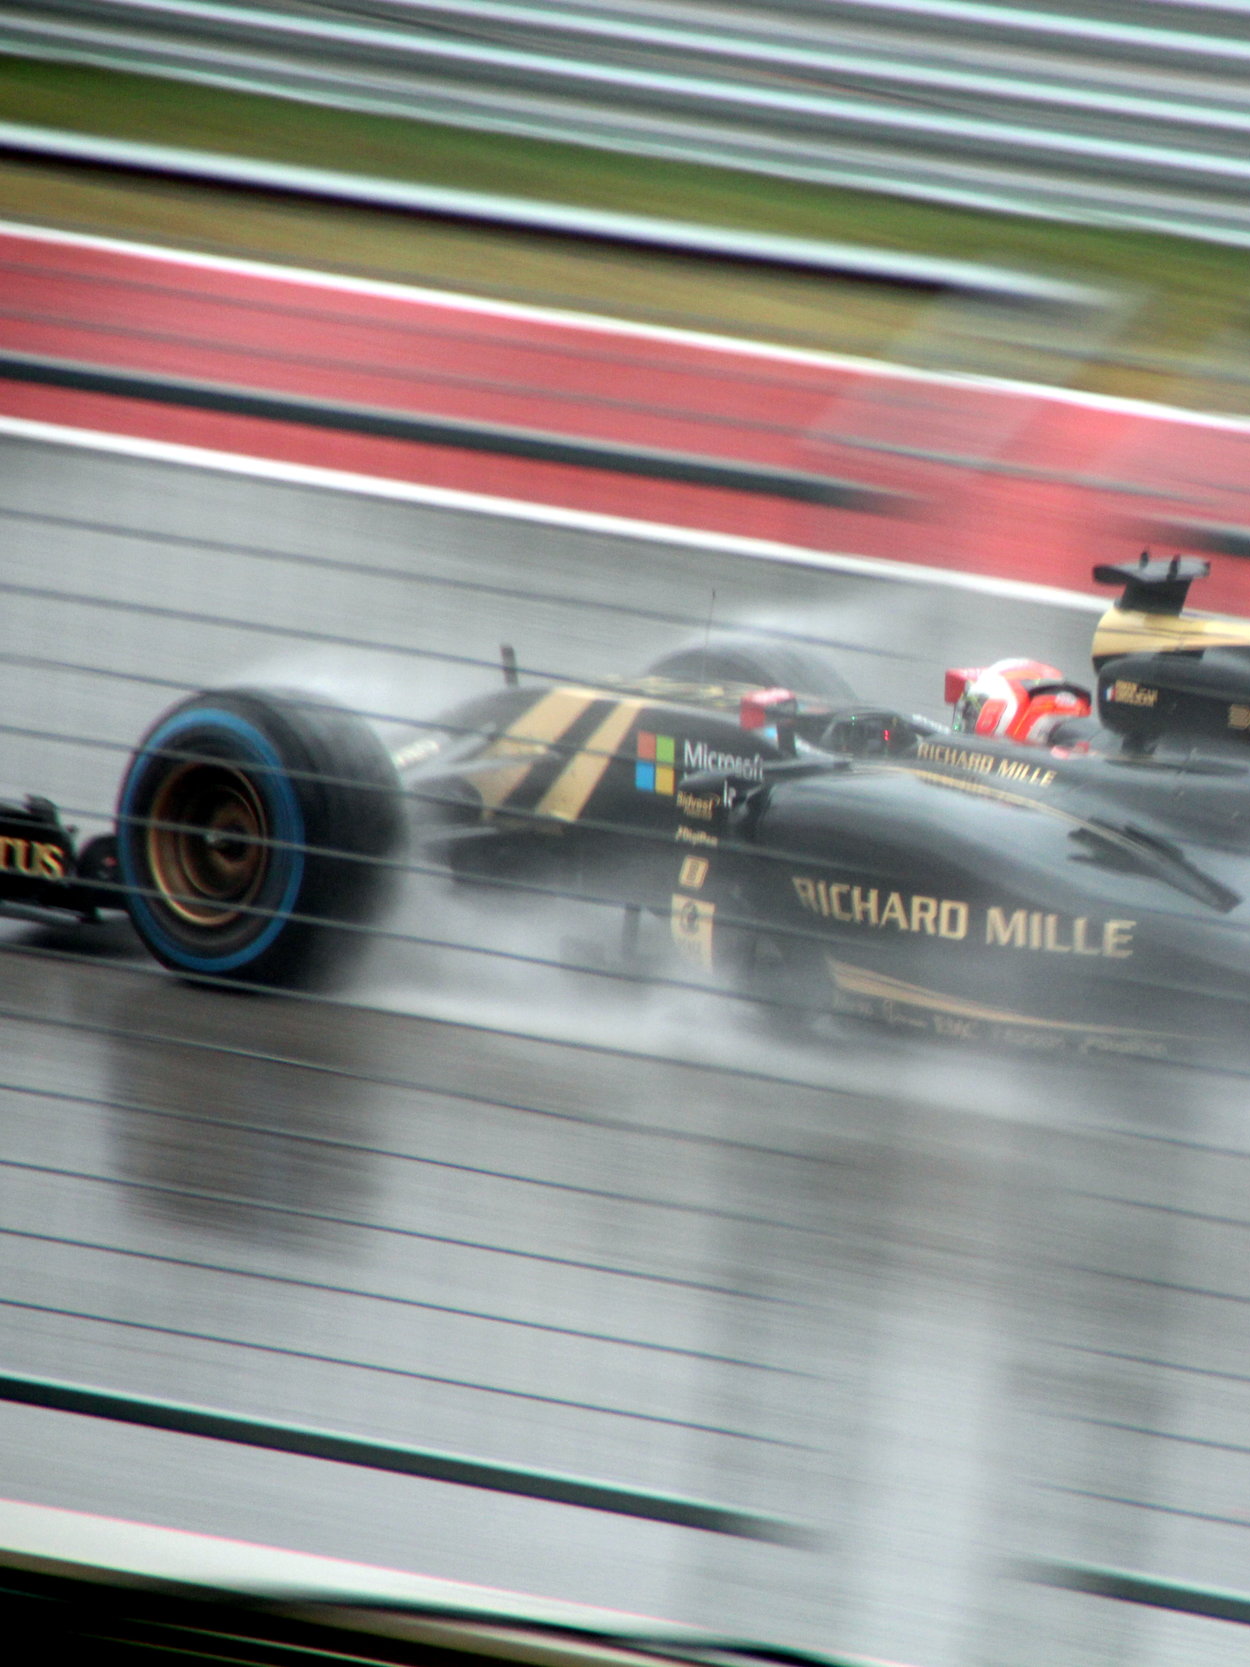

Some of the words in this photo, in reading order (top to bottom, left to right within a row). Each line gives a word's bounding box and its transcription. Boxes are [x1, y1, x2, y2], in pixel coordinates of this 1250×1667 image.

[683, 739, 764, 781] Microsoft
[917, 742, 995, 775] RICHARD
[998, 758, 1058, 788] MILLE
[792, 876, 969, 941] RICHARD
[985, 906, 1137, 959] MILLE
